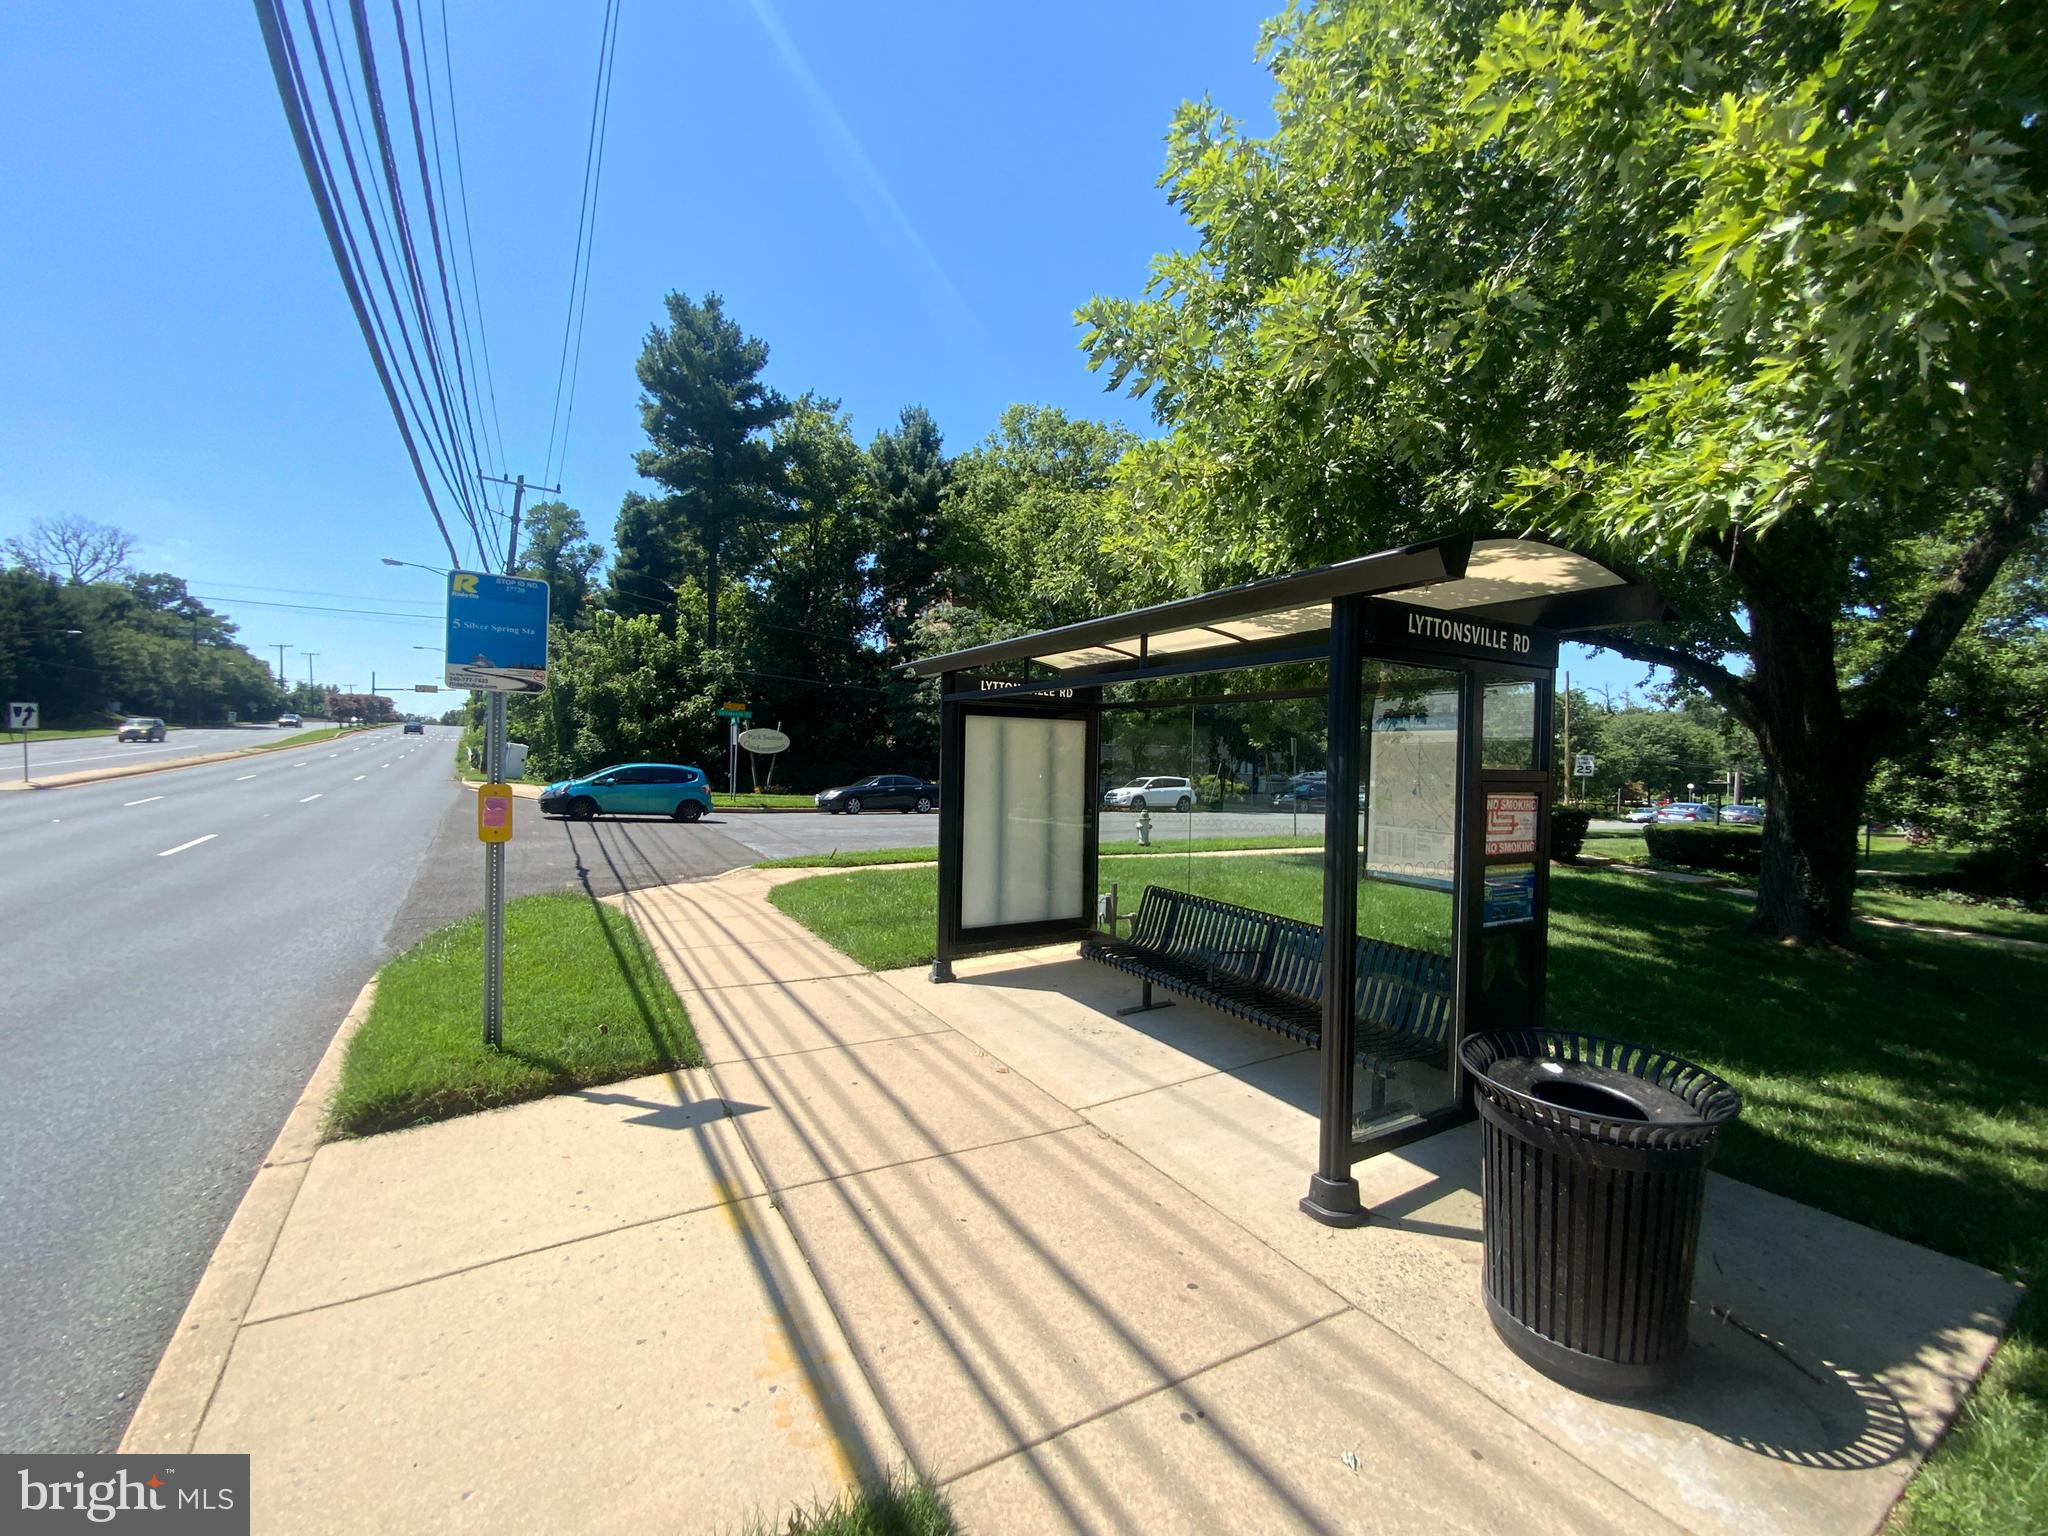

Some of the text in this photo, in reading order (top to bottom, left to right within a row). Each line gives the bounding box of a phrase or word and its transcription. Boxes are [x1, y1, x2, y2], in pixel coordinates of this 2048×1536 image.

[453, 574, 479, 594] R
[496, 578, 516, 586] STOP
[452, 618, 535, 635] 5 Silver Spring Sta
[1408, 612, 1530, 653] LYTTONSVILLE RD
[1059, 688, 1073, 698] RD
[1576, 765, 1592, 774] 25
[1487, 799, 1537, 810] NO SMOKING
[1486, 841, 1535, 855] NO SMOKING
